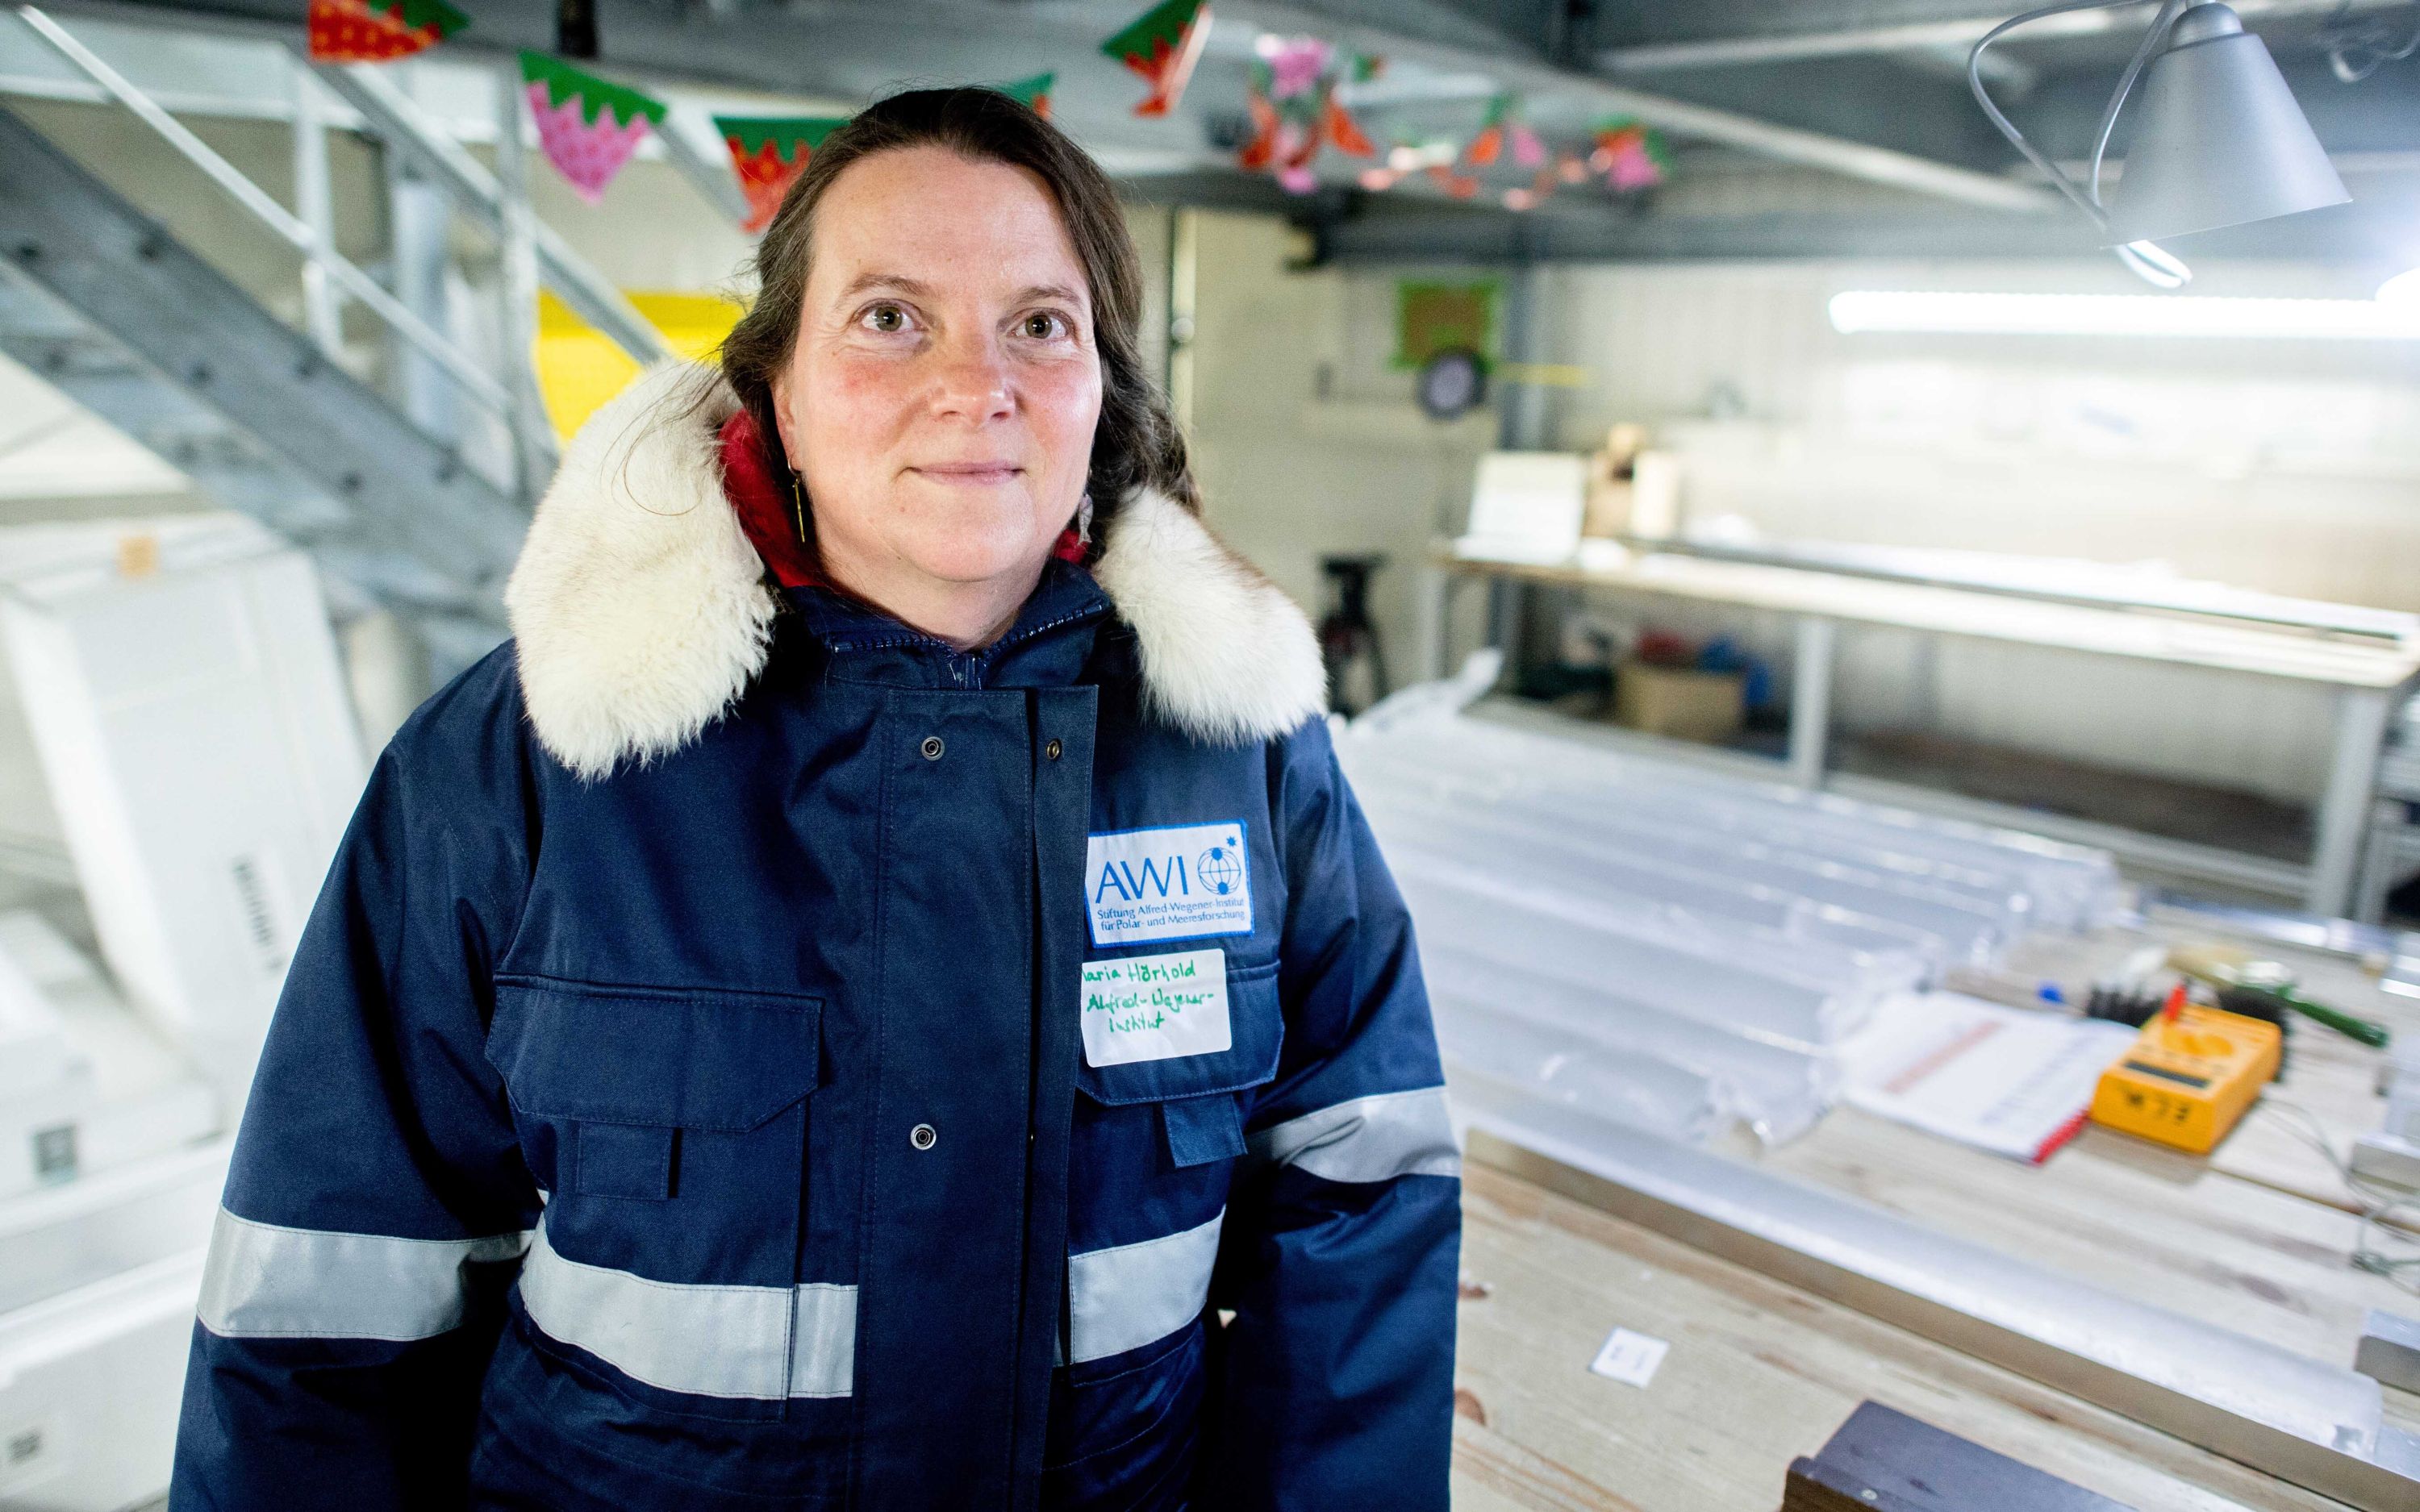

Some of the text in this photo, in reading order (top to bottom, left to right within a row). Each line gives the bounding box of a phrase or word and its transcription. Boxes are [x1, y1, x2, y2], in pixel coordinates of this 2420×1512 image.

[1095, 855, 1189, 904] AWI
[1097, 897, 1245, 919] Stiftung Alfred-Wegener-Institut
[1100, 910, 1245, 931] für Polar- und Meeresforschung
[1082, 959, 1196, 982] aria Hörhold
